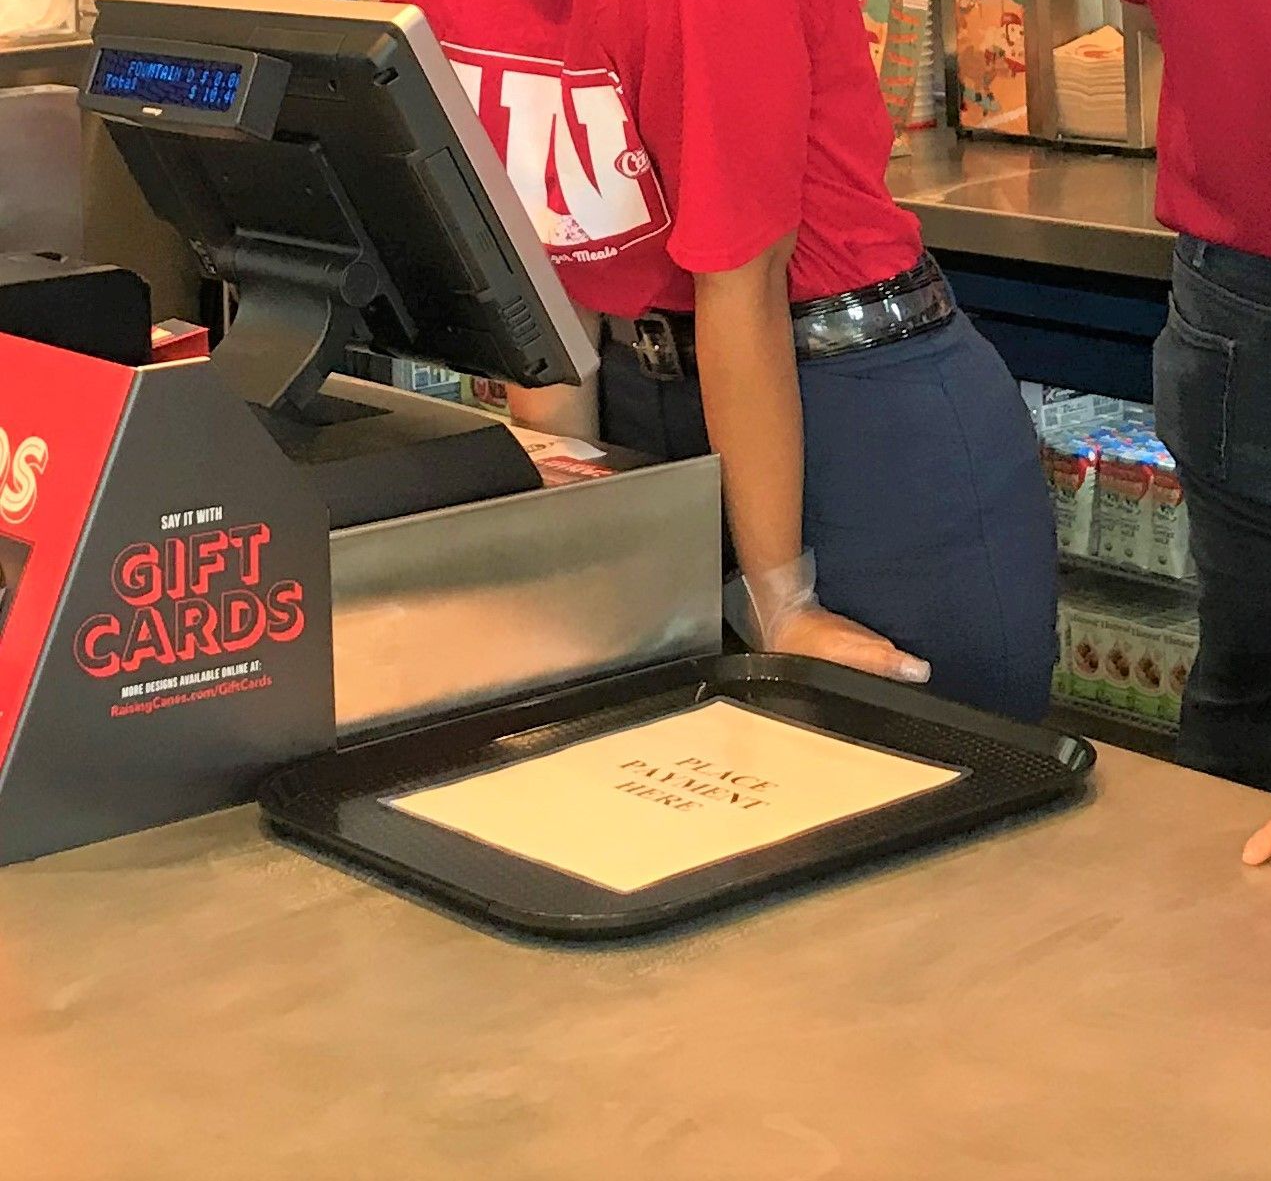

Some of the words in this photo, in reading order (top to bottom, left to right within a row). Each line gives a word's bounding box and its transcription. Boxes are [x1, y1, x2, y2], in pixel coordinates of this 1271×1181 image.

[104, 73, 137, 91] Total
[128, 61, 182, 82] FOUNTAIN
[571, 246, 618, 262] Meals
[161, 513, 181, 530] SAY
[184, 510, 194, 526] IT
[197, 506, 223, 524] WITH
[111, 522, 270, 606] GIFT
[73, 579, 306, 678] CARDS
[121, 684, 143, 698] MORE
[145, 677, 178, 693] DESIGNS
[180, 668, 220, 686] AVAILABLE
[221, 662, 248, 678] ONLINE
[250, 660, 262, 672] AT:
[619, 760, 770, 809] PAYMENT
[676, 757, 778, 792] PLACE
[615, 781, 703, 812] HERE
